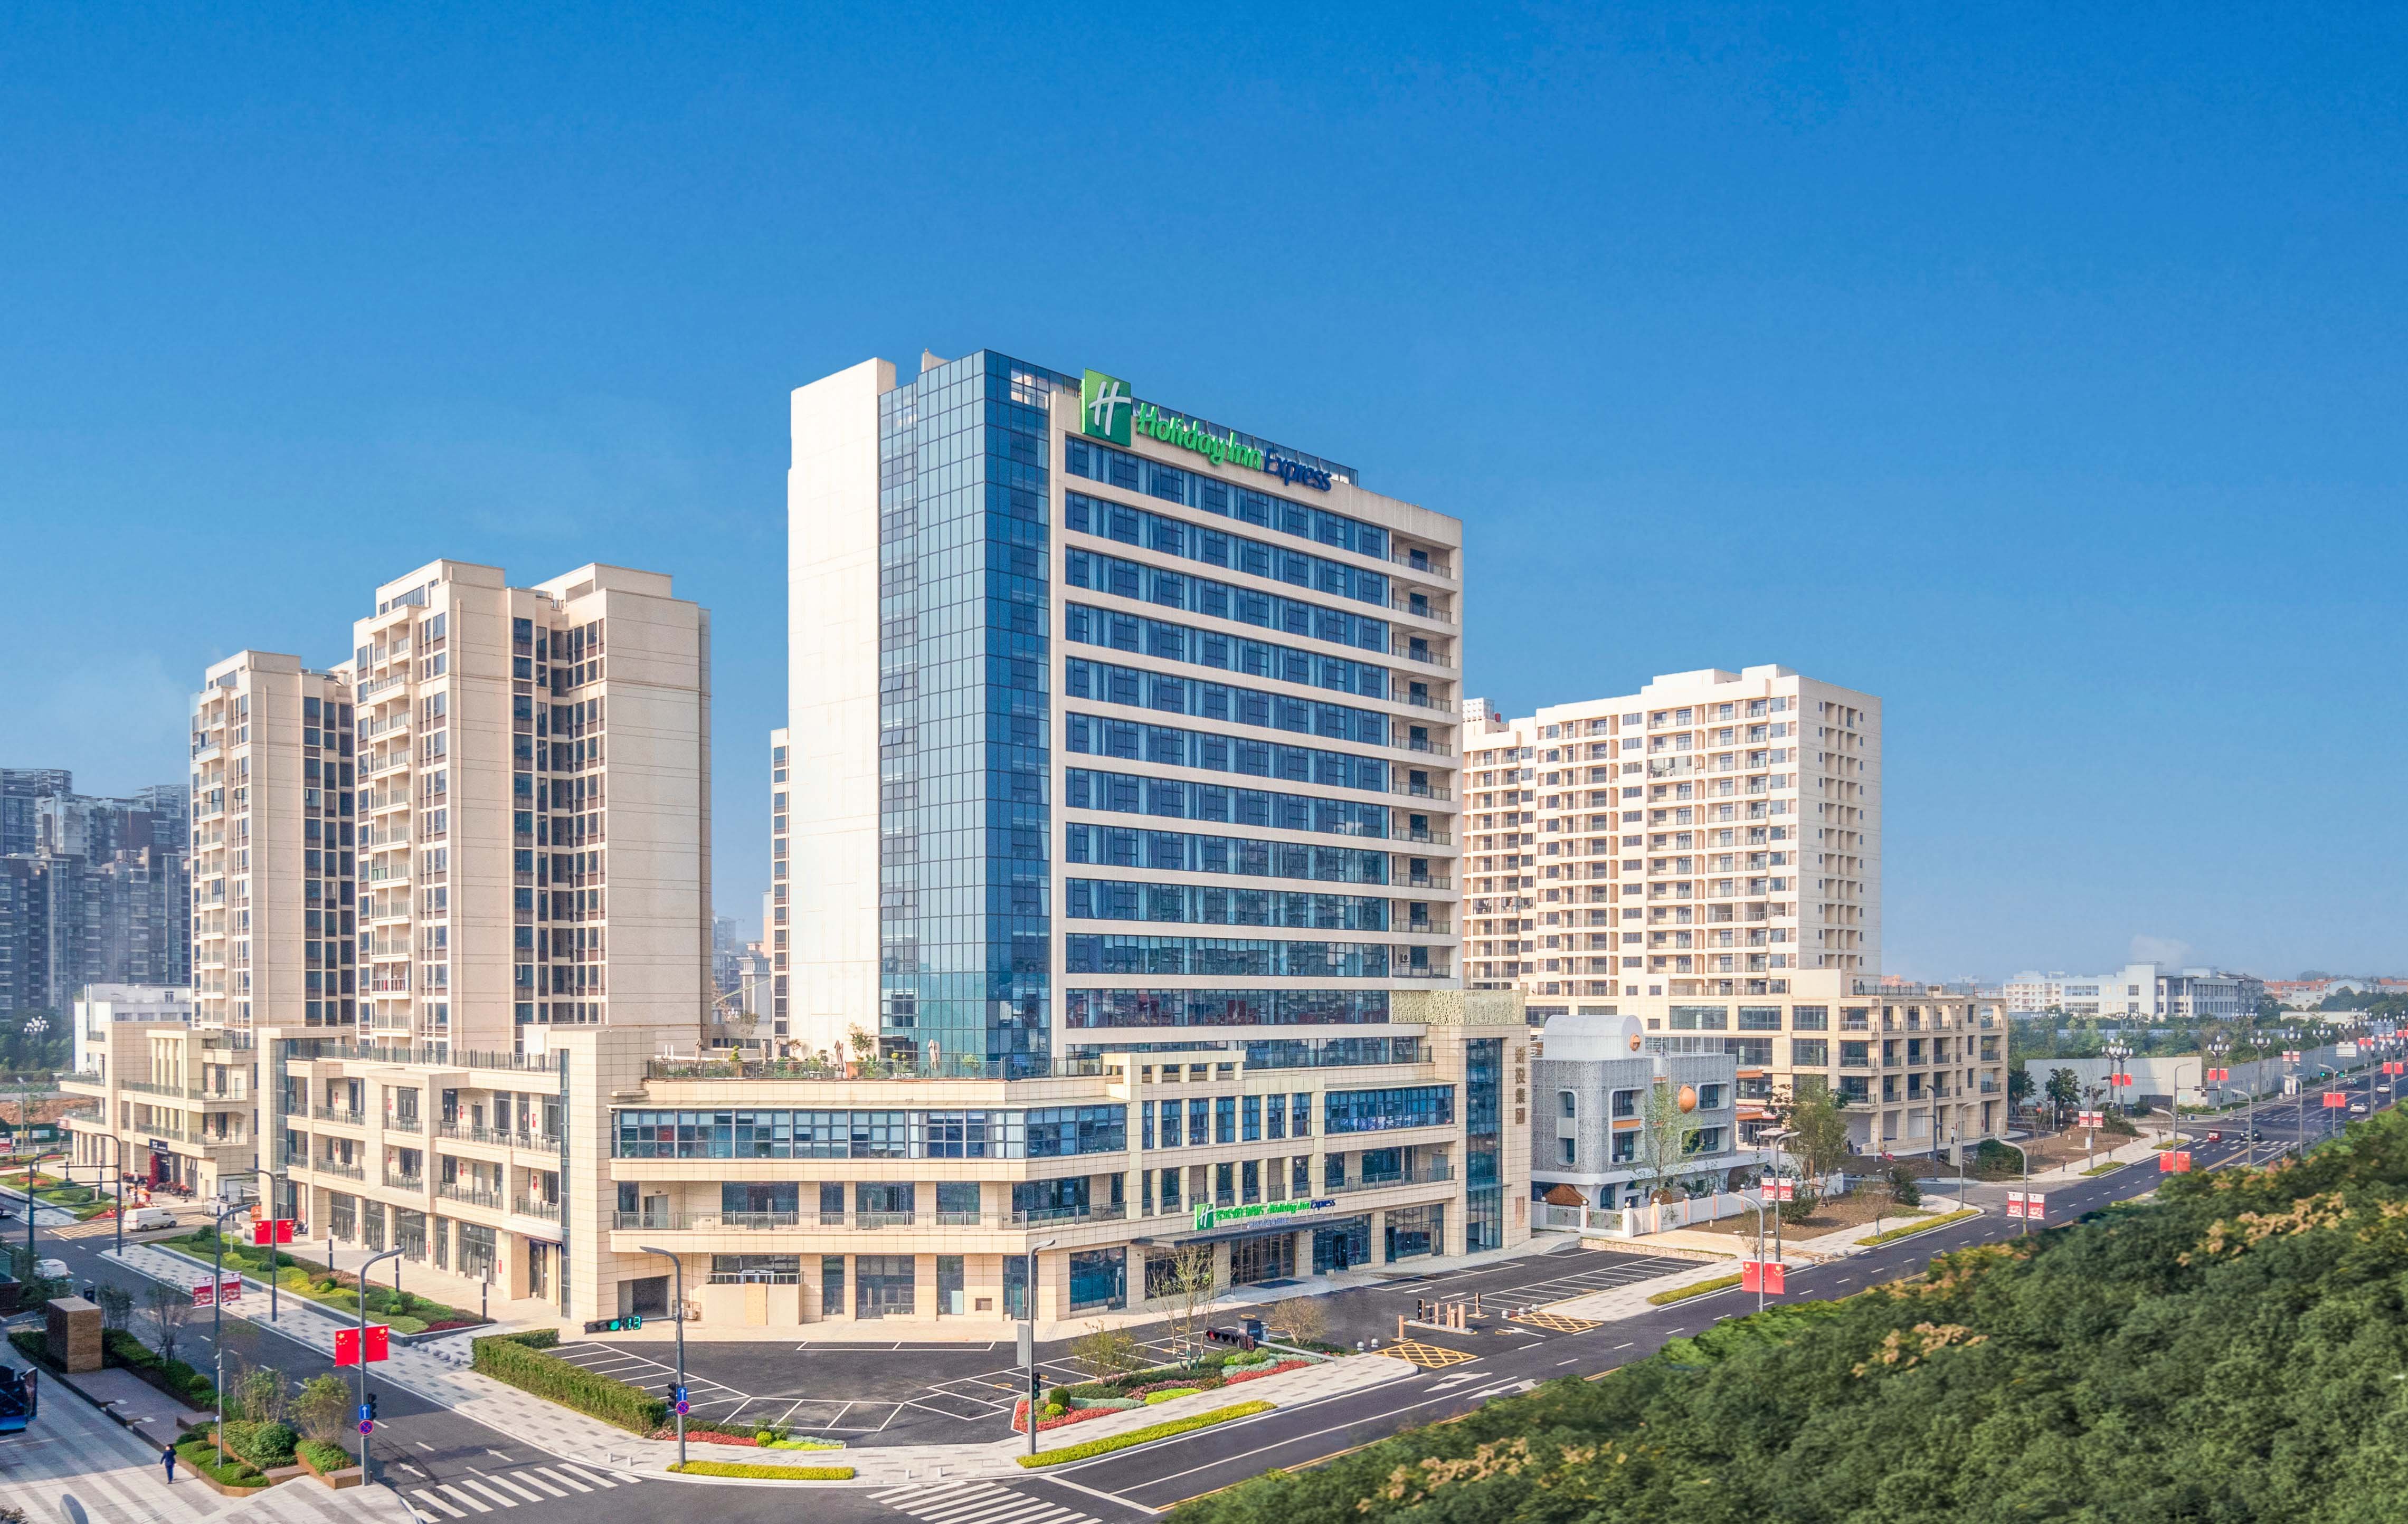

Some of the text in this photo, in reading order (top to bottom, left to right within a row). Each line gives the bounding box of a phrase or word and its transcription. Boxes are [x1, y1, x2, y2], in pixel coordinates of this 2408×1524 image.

[1088, 380, 1132, 436] H
[1137, 403, 1332, 492] Holiday Inn Express
[628, 1316, 641, 1330] 13
